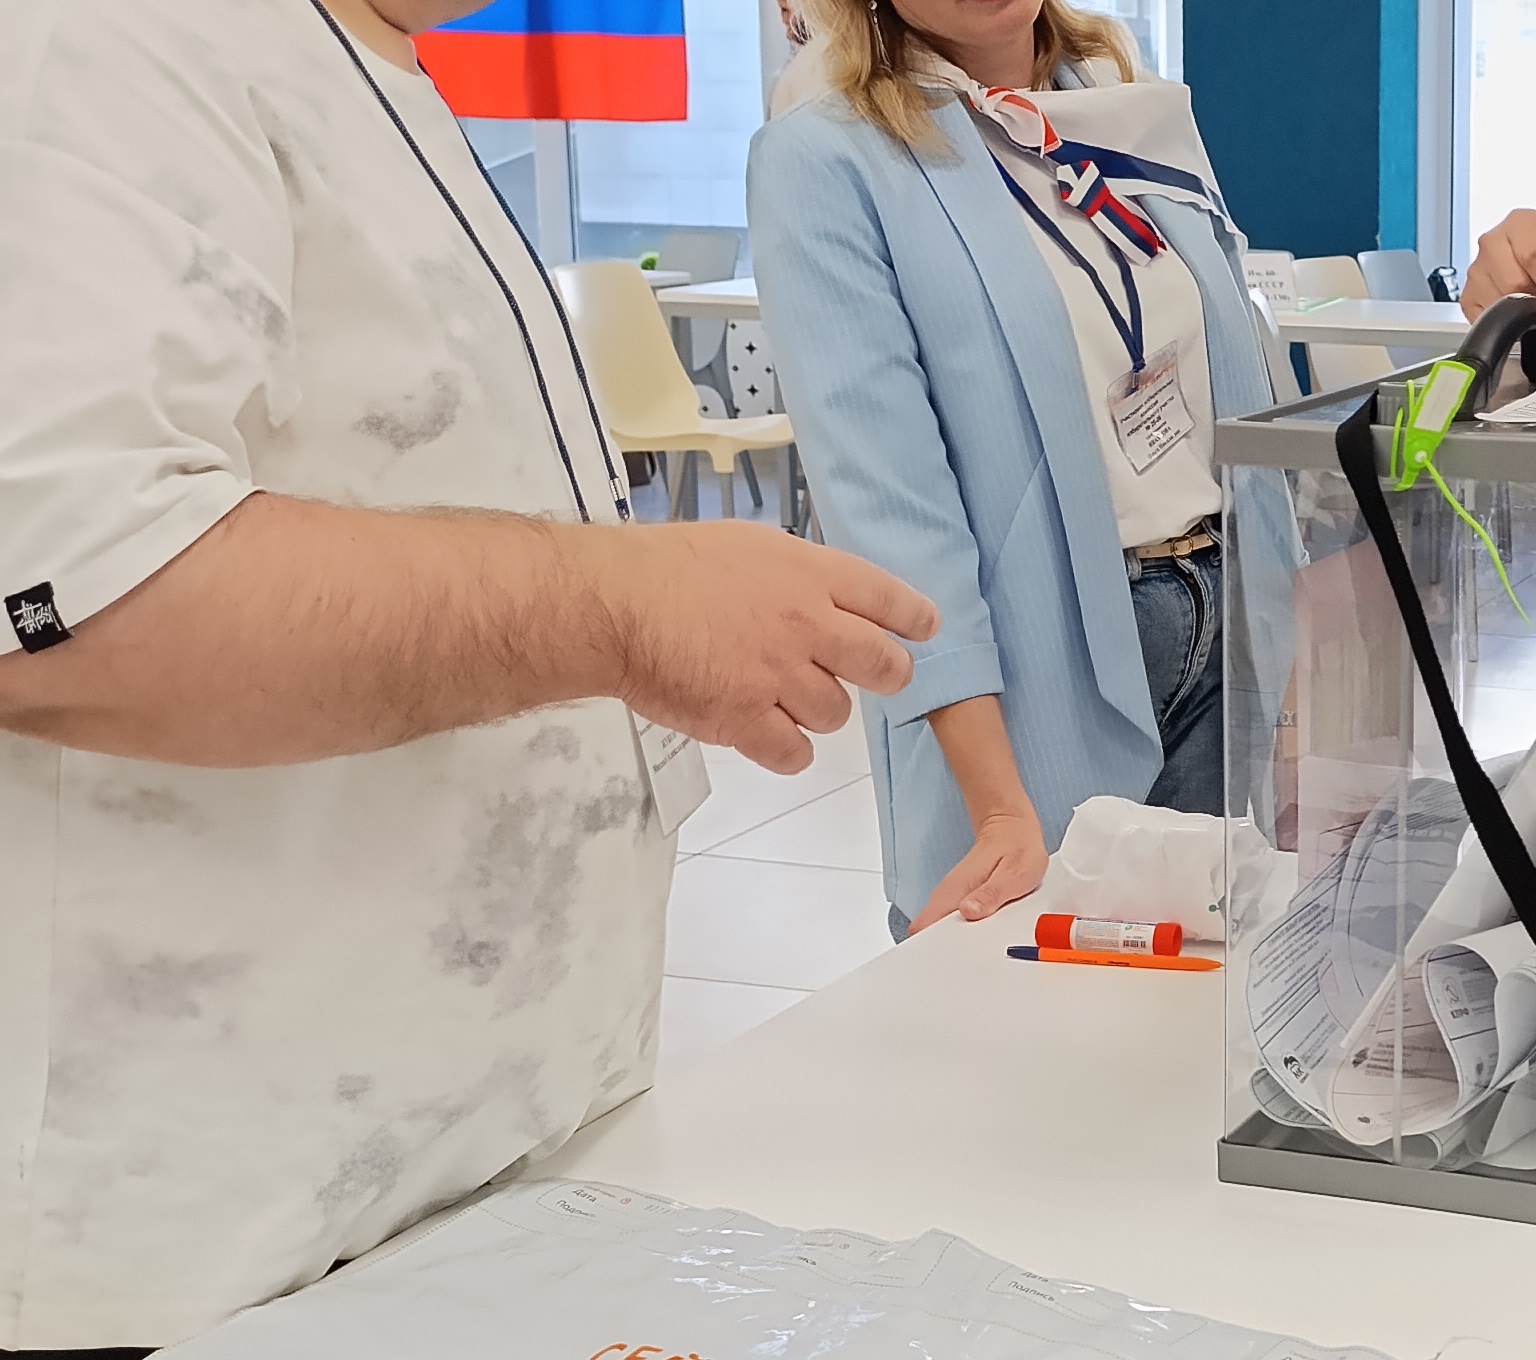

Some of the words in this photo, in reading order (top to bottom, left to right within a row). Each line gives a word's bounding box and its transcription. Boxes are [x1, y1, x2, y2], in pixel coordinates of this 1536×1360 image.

[572, 1189, 597, 1203] Дата
[1021, 1271, 1049, 1283] Дата
[1008, 1280, 1055, 1302] Подпись
